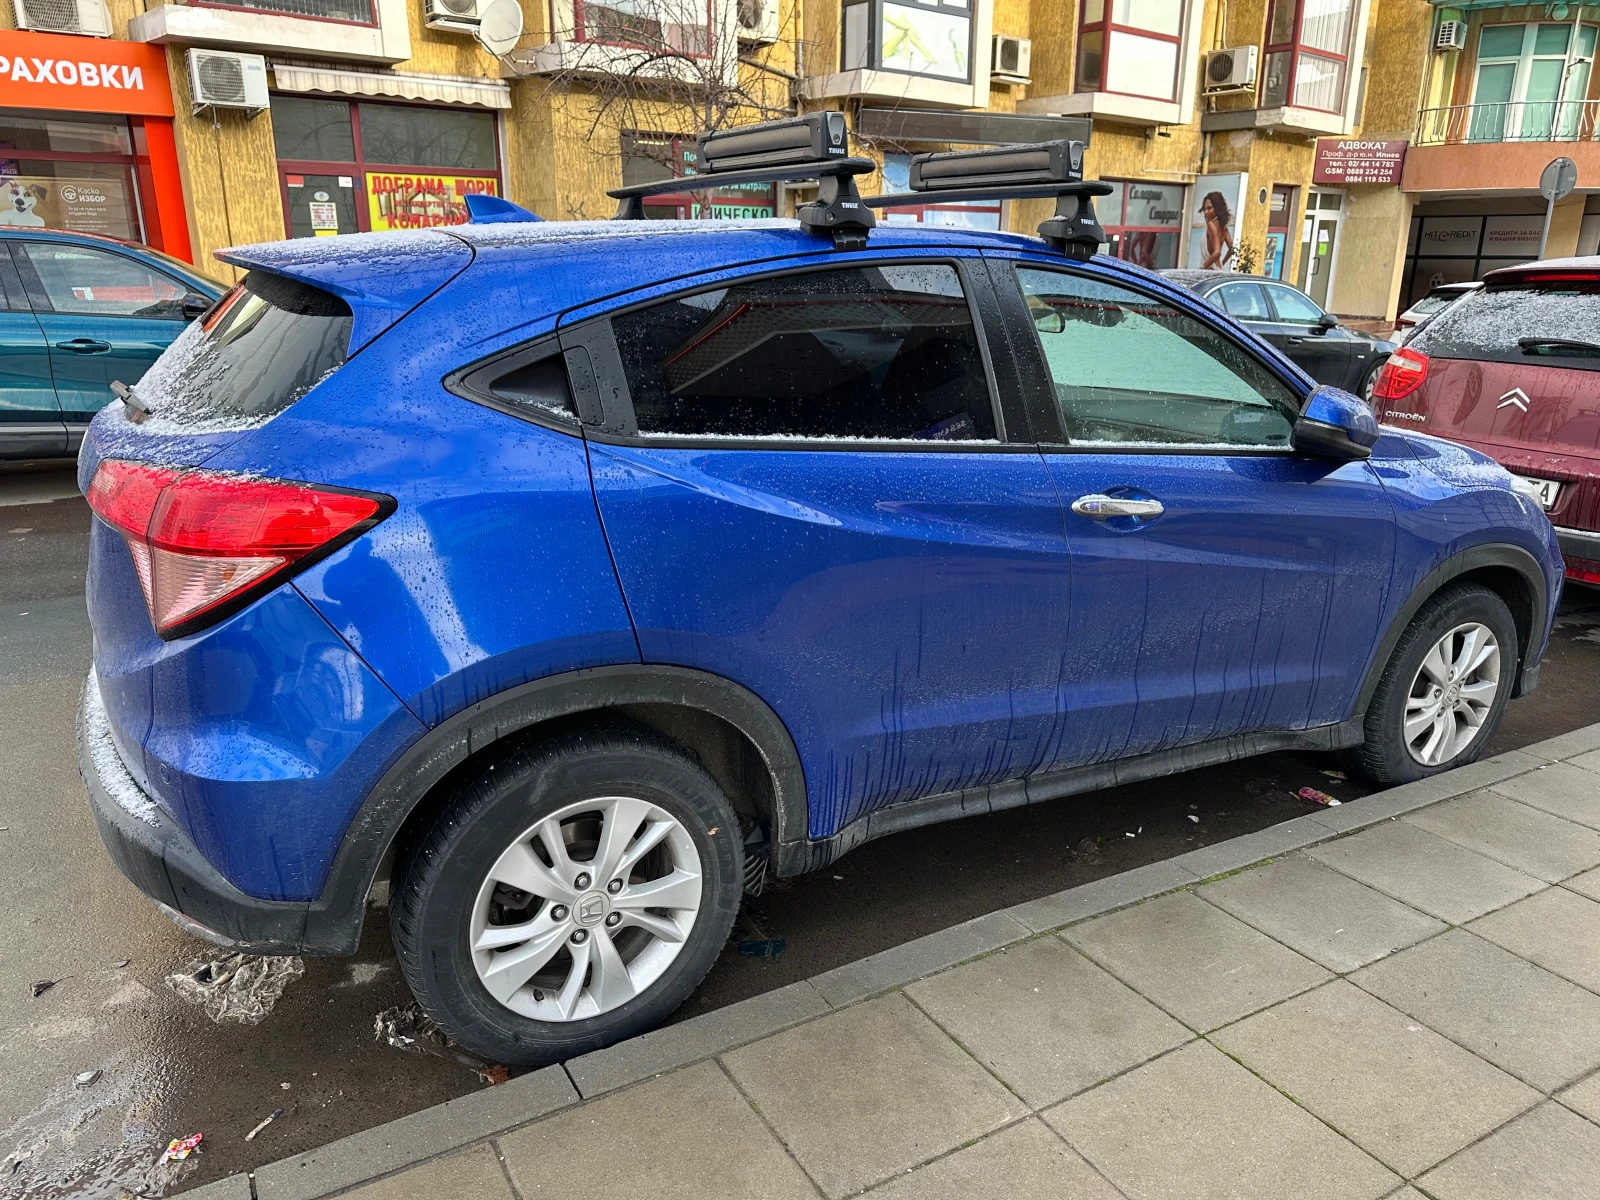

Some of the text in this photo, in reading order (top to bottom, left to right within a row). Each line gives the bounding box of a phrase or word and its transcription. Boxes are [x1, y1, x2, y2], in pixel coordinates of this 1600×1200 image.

[1338, 141, 1388, 150] АДВОКАТ
[828, 147, 845, 155] THULE
[1322, 150, 1345, 158] Проф.
[371, 175, 446, 195] ДОГРАМА
[77, 187, 100, 195] Каско
[694, 206, 769, 219] ИИЧЕСКО
[1081, 218, 1095, 226] THULE
[1385, 410, 1426, 422] CITROËN
